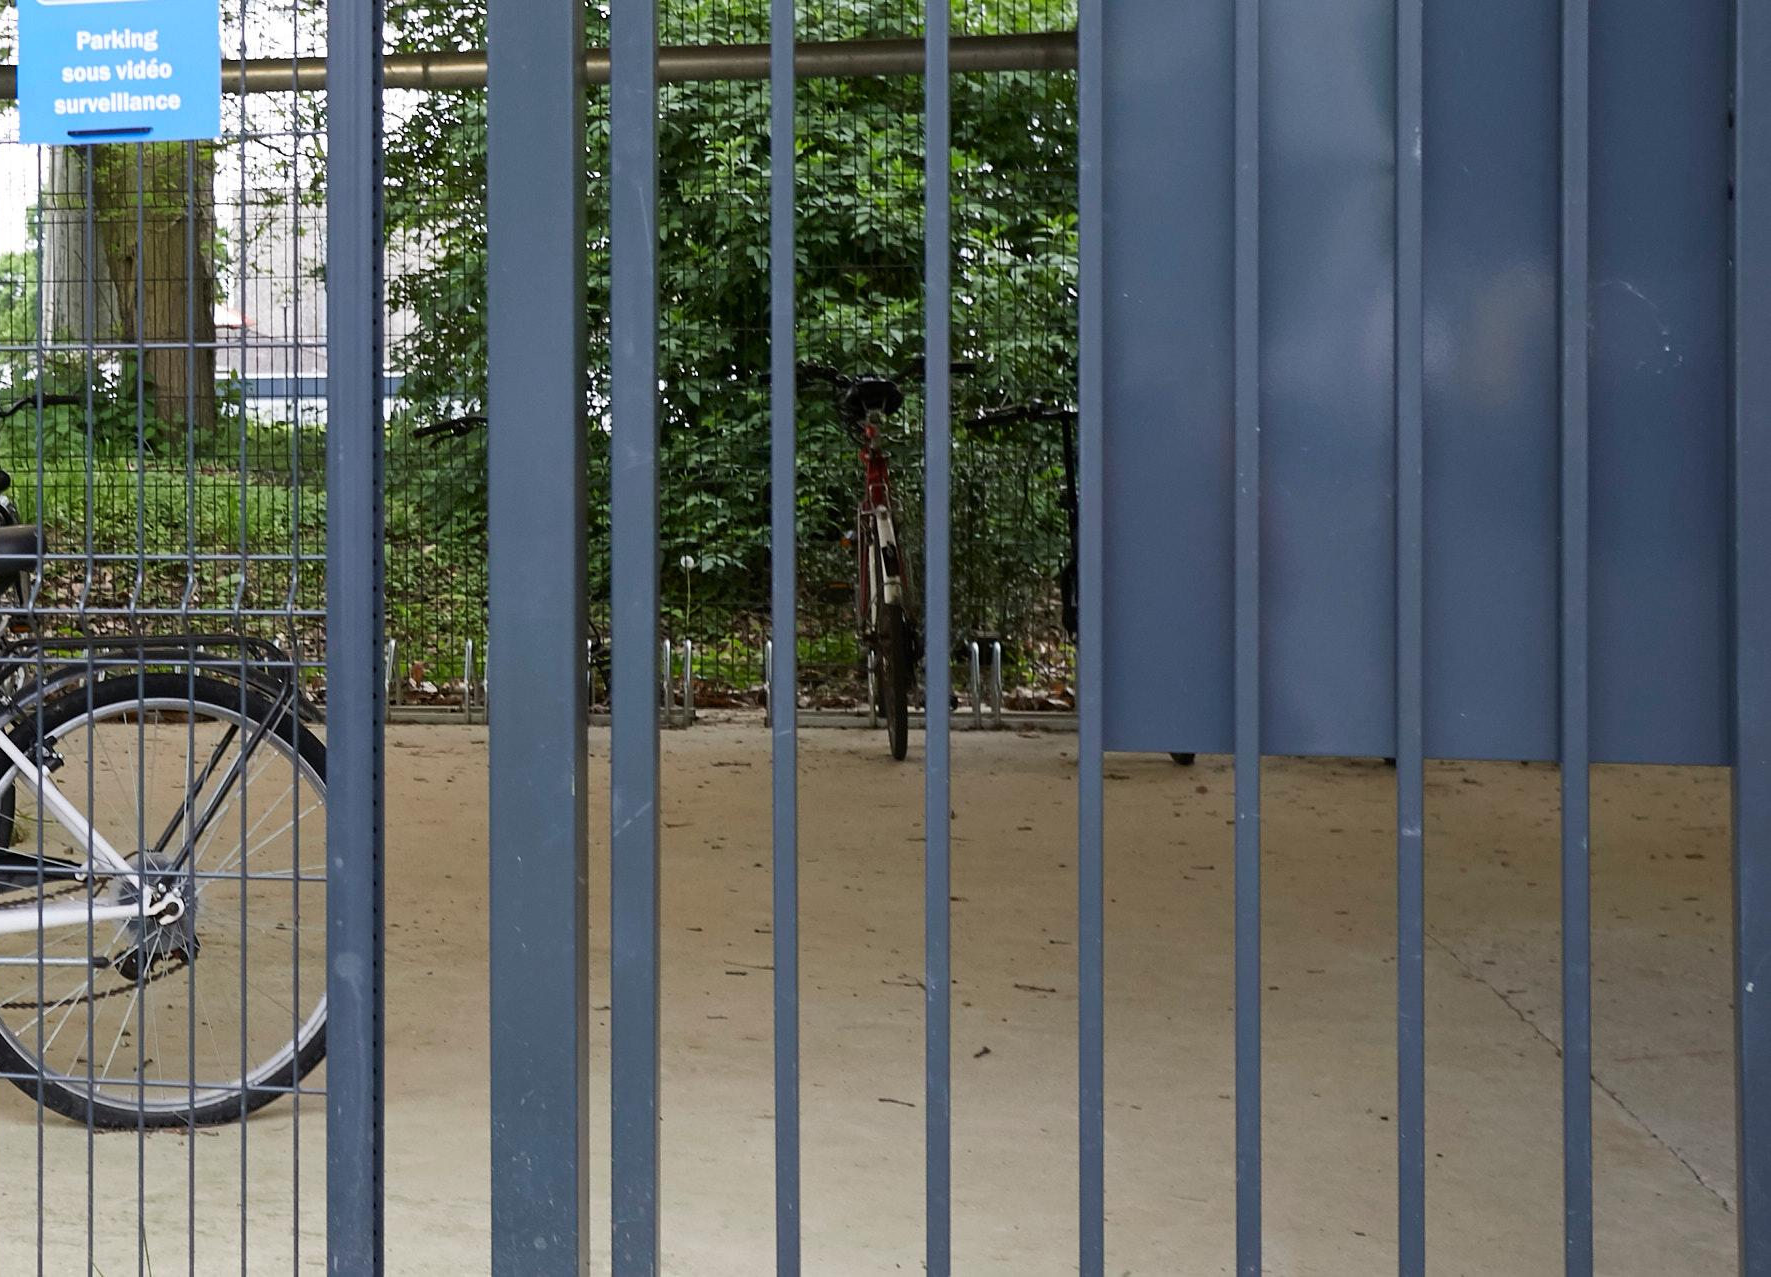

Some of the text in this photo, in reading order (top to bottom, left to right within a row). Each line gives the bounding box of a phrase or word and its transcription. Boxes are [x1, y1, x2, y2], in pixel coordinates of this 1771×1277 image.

[76, 29, 158, 51] Parking
[61, 59, 173, 83] sous vidéo
[54, 92, 181, 115] surveillance
